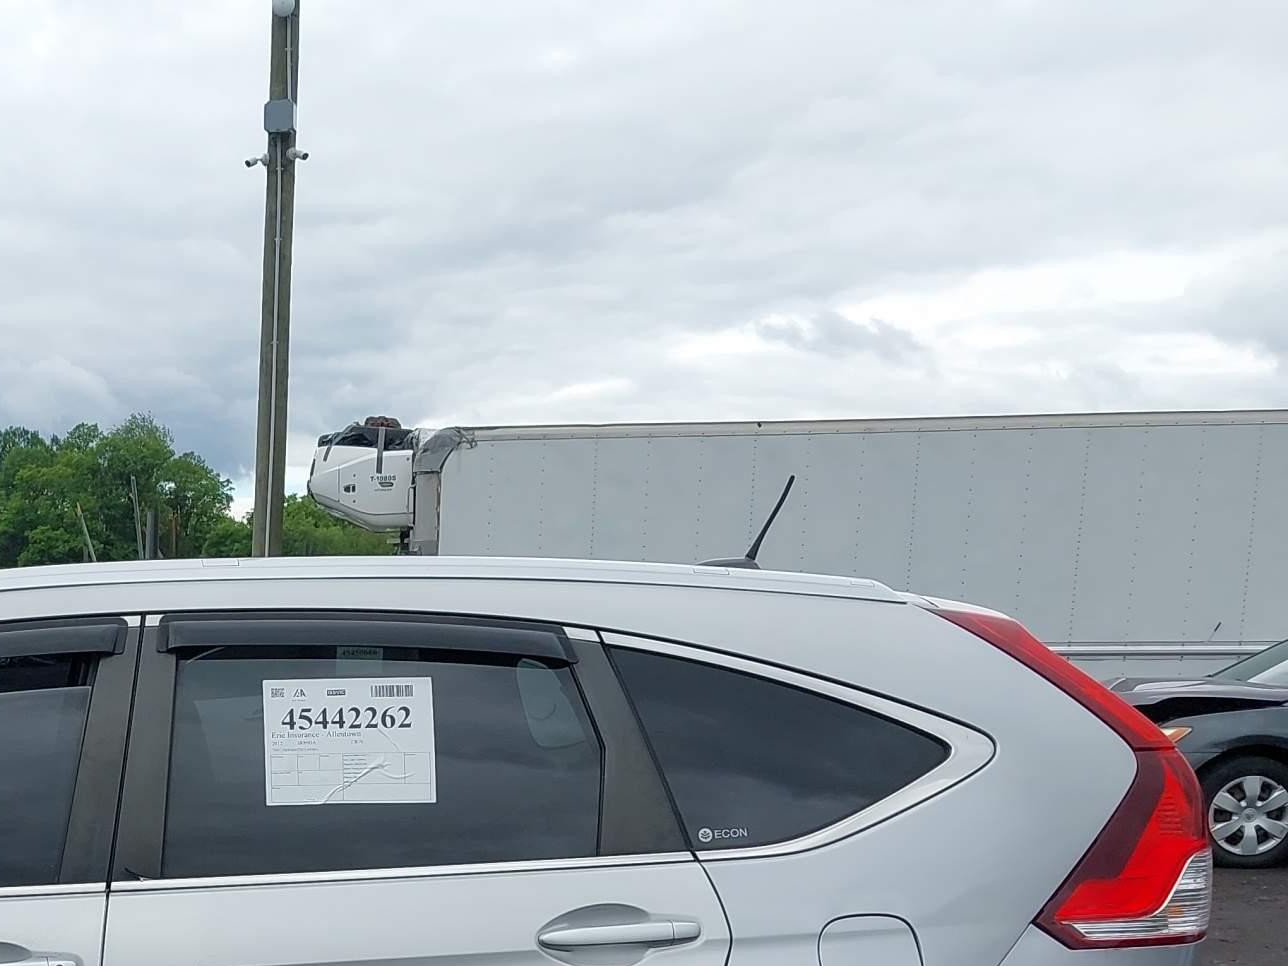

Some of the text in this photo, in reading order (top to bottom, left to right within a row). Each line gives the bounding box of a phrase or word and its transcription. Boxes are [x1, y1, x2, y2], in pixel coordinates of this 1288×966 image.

[281, 706, 412, 731] 45442262
[287, 731, 320, 739] Insurance
[714, 828, 748, 839] ECON
